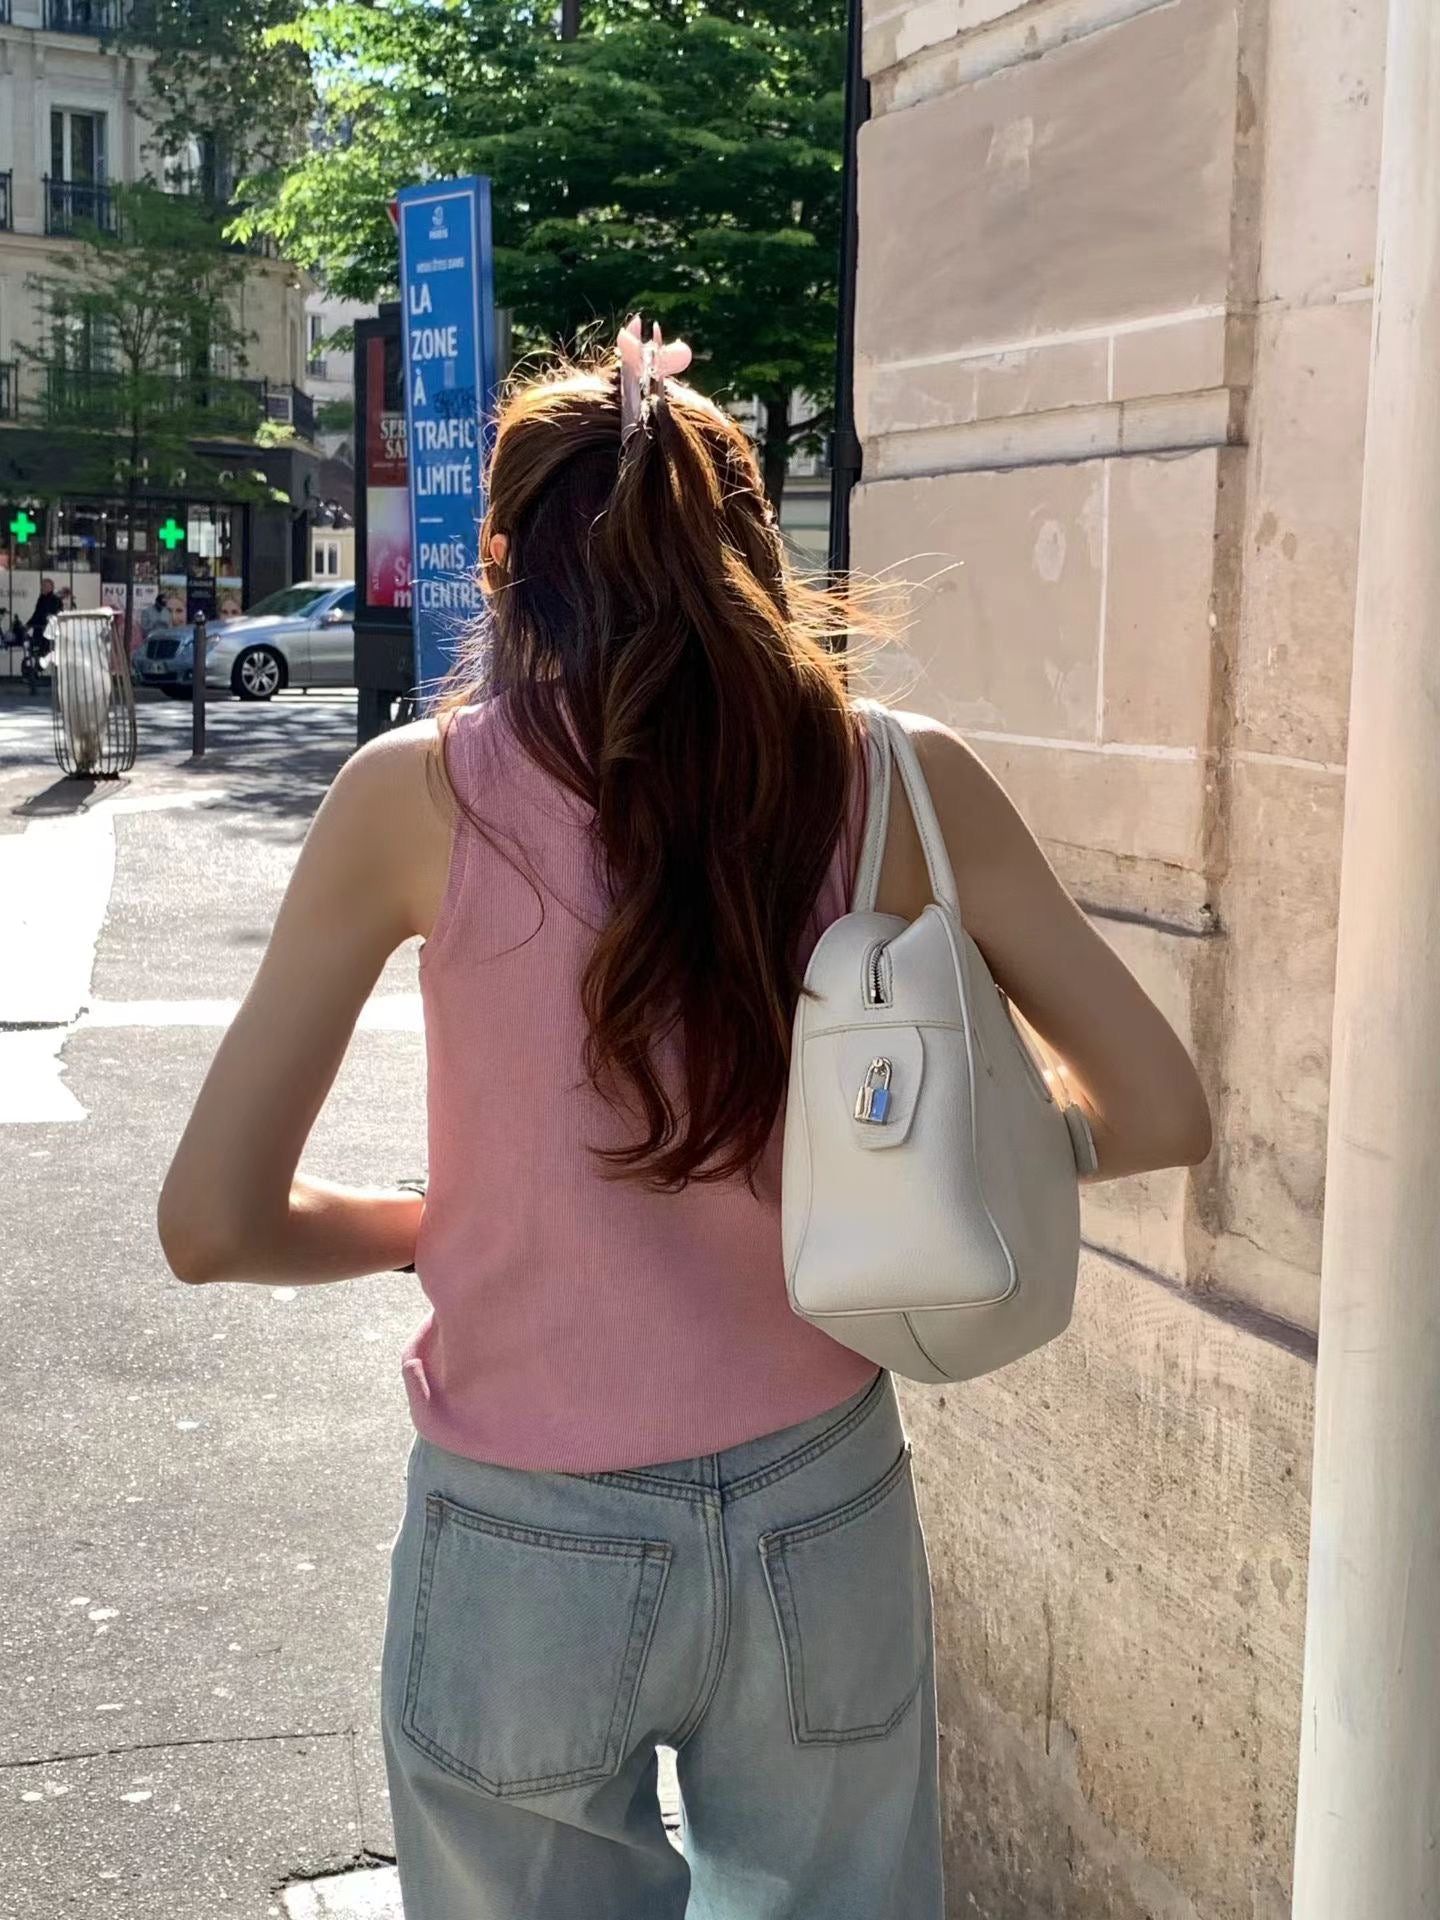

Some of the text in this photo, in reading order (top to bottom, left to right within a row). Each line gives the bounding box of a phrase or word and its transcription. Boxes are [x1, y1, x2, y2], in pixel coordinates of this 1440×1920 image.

[410, 283, 433, 315] LA
[411, 326, 458, 361] ZONE
[413, 368, 427, 406] À
[414, 418, 475, 451] TRAFIC
[417, 456, 472, 496] LIMITÉ
[420, 543, 465, 570] PARIS
[421, 581, 481, 609] CENTRE
